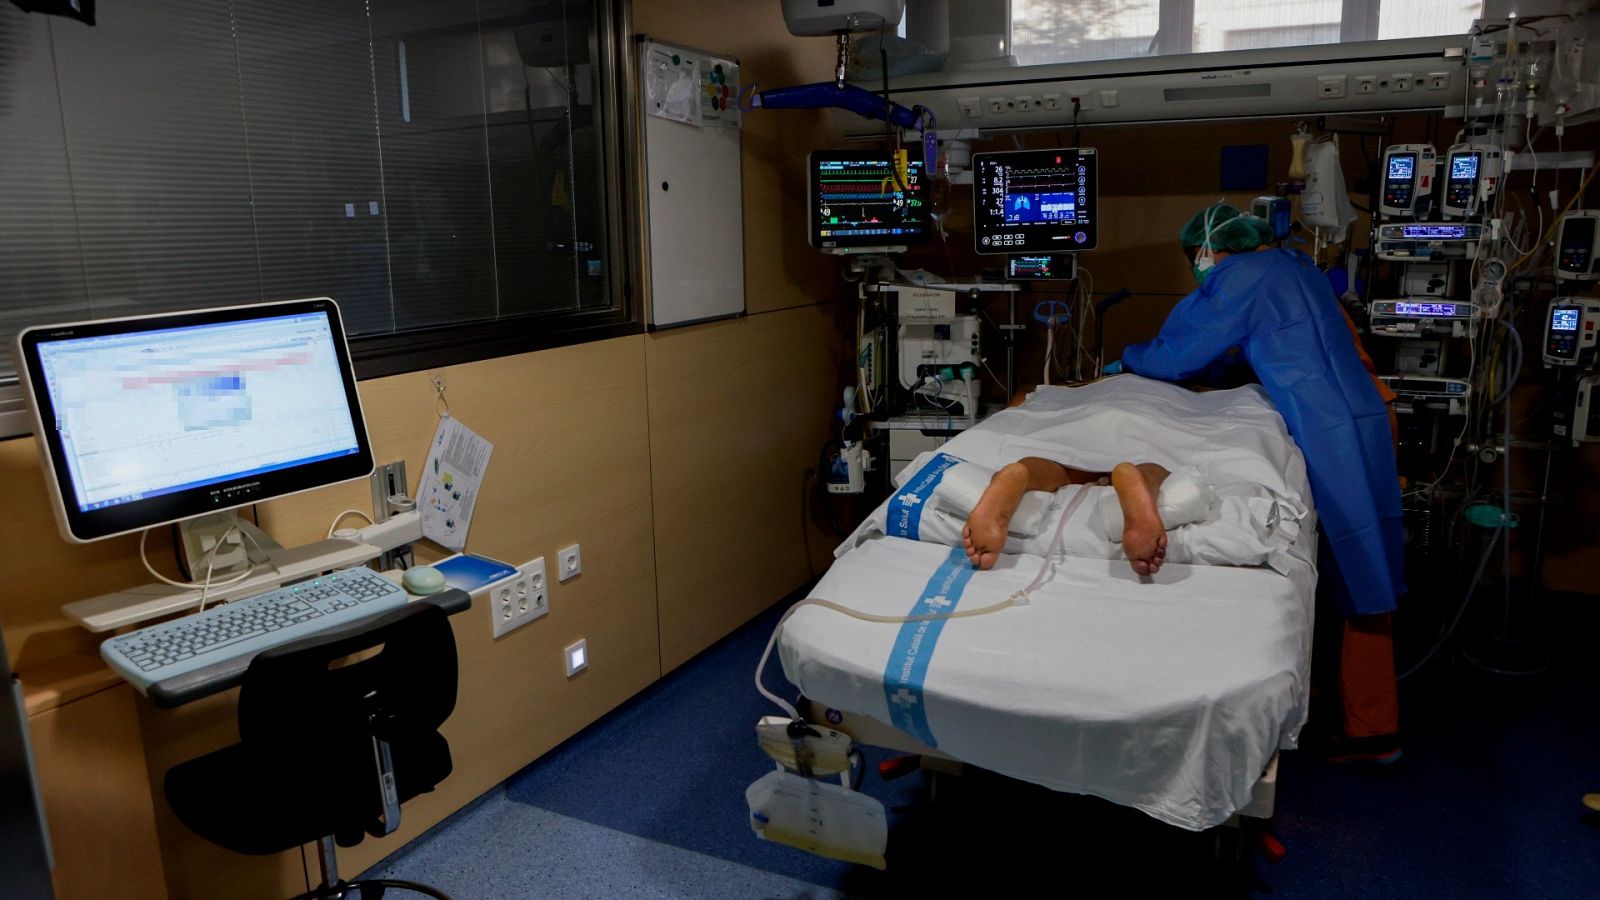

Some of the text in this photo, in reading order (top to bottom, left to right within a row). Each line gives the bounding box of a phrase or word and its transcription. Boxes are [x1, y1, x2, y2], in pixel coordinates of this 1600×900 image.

[910, 176, 918, 184] 27
[896, 199, 904, 207] 49
[823, 208, 831, 217] 49
[899, 509, 910, 529] Salut
[907, 633, 924, 656] Català
[899, 655, 916, 684] Institut
